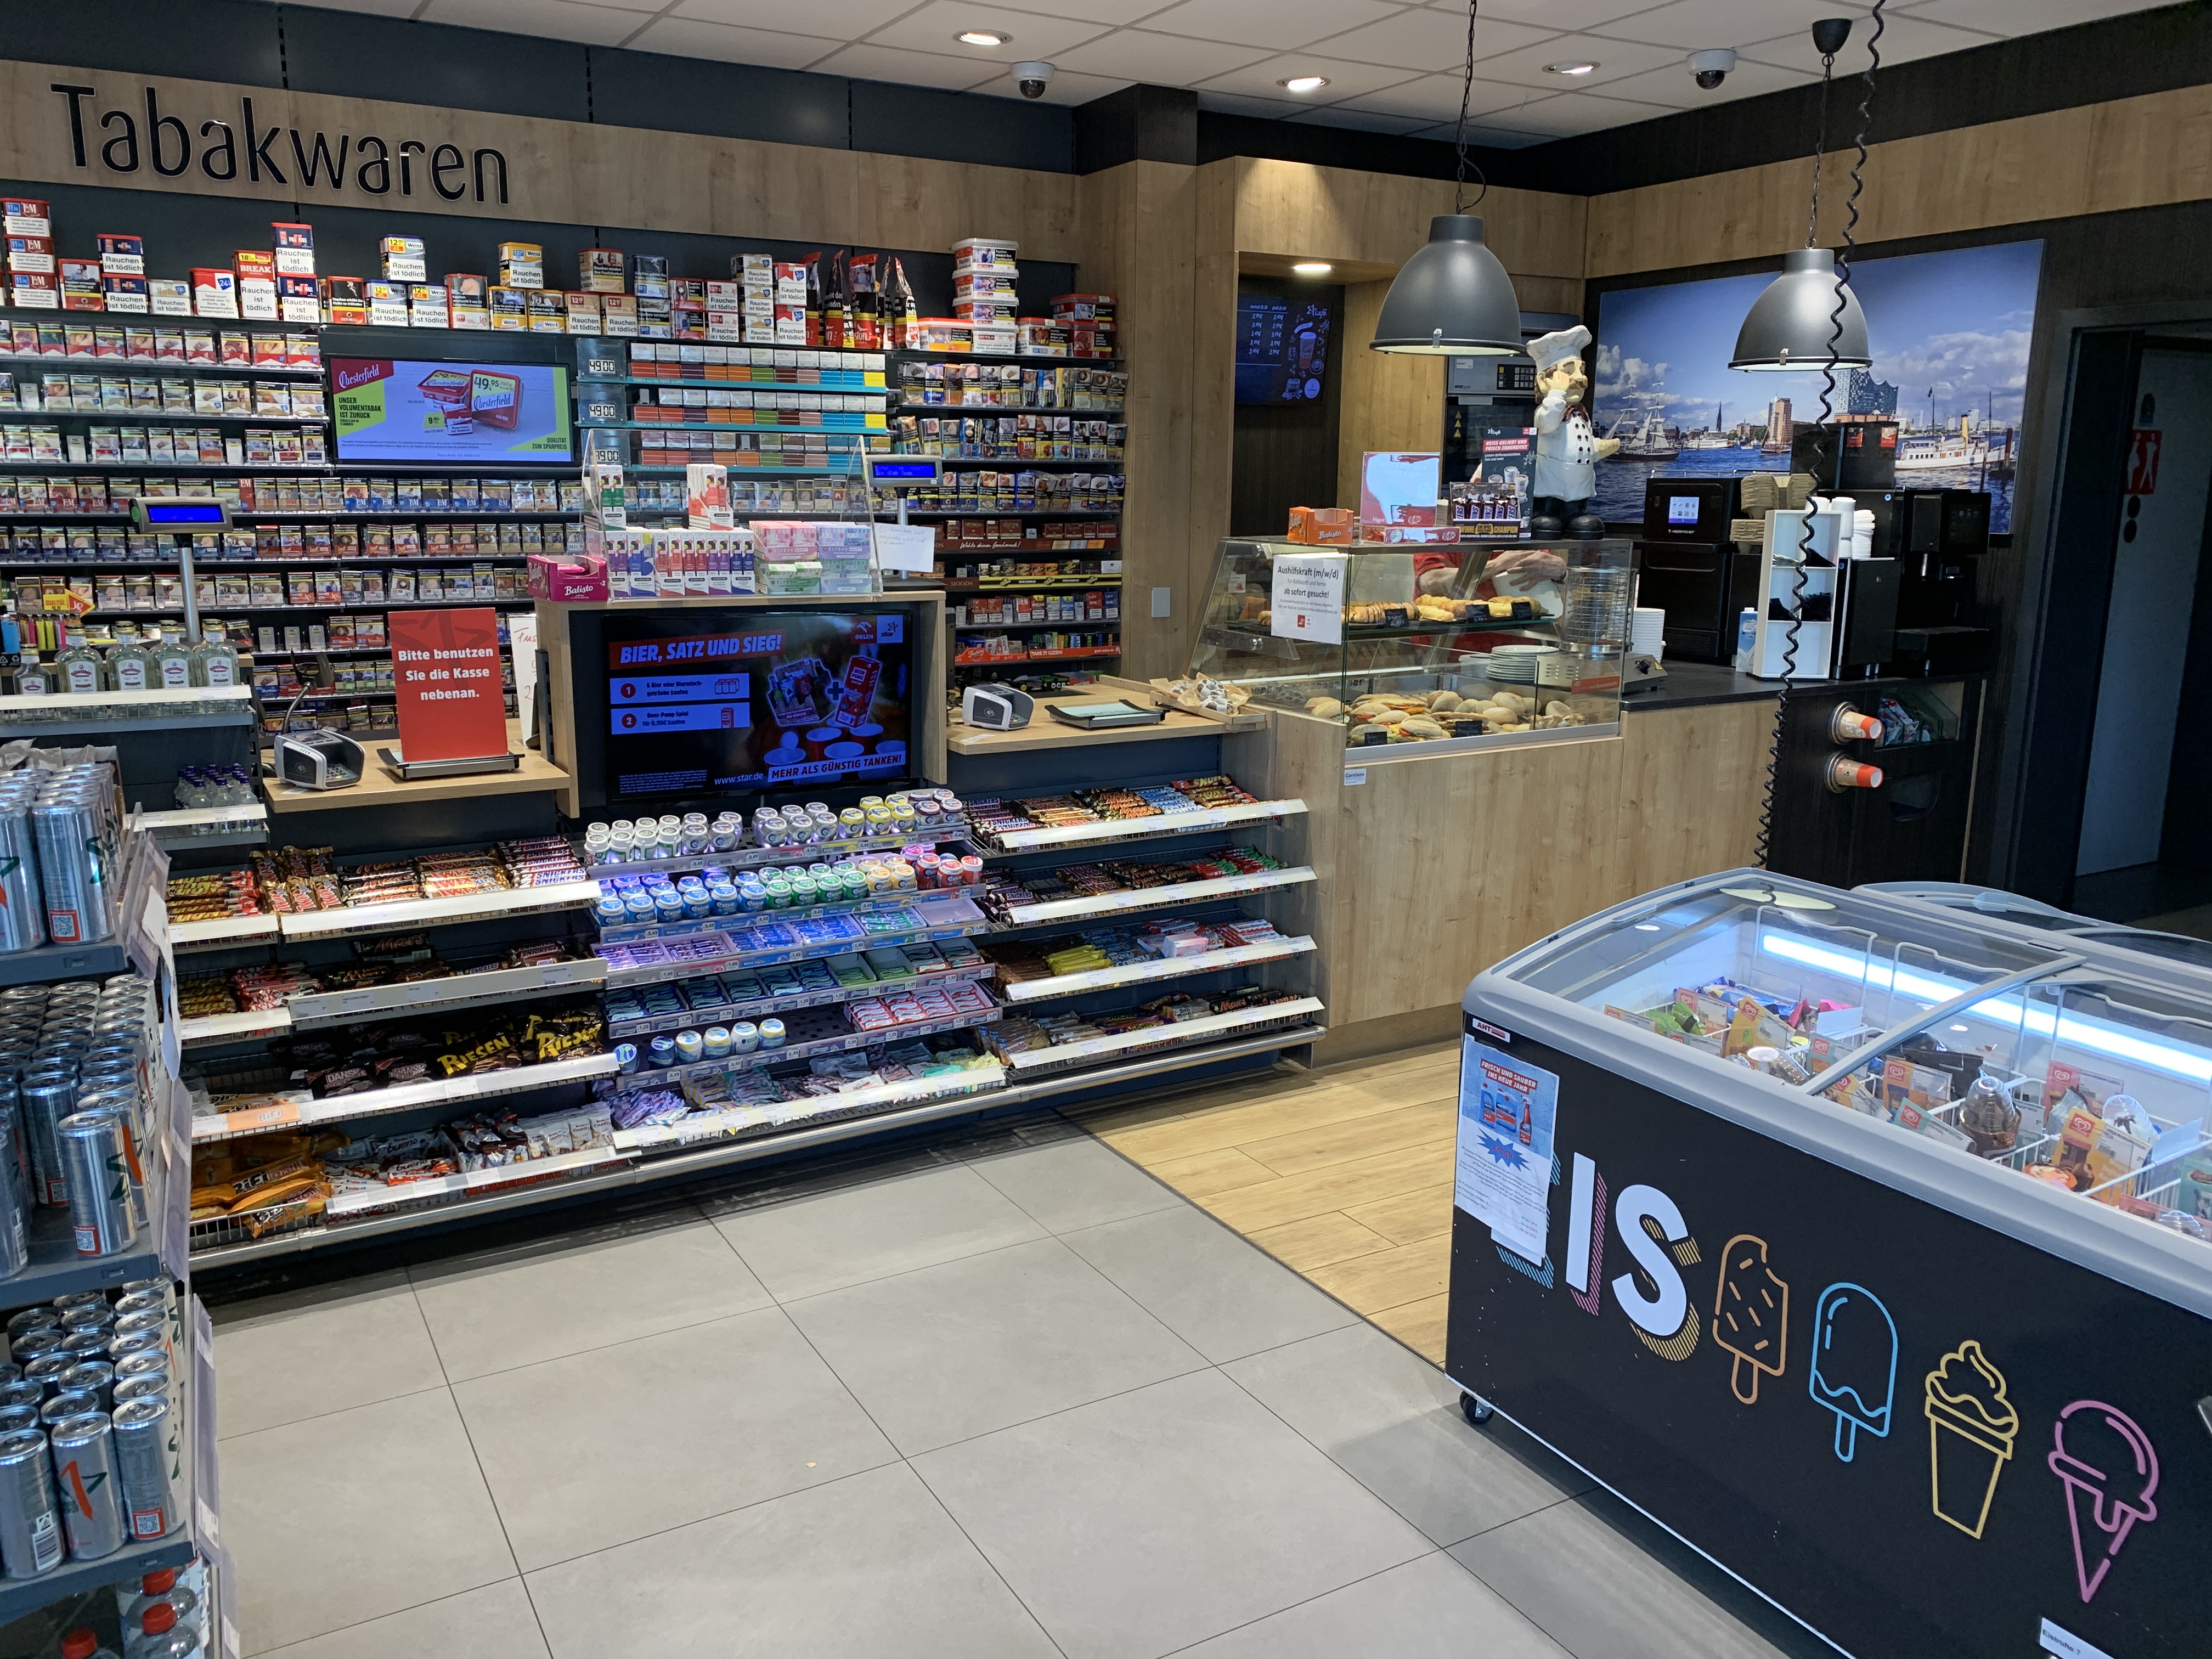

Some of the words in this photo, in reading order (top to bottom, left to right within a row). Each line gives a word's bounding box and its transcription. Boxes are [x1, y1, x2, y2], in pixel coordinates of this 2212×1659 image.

[50, 83, 510, 205] Tabakwaren
[105, 256, 139, 264] Rauchen
[113, 263, 142, 272] tödlich
[240, 265, 271, 273] BREAK
[110, 295, 143, 303] Rauchen
[1314, 308, 1328, 319] café
[338, 364, 380, 388] Chesterfield
[339, 404, 382, 413] VOLUMENTABAK
[474, 393, 511, 411] Chesterfield
[589, 405, 615, 416] 49.00
[1318, 530, 1341, 539] Balisto
[1278, 565, 1312, 576] Aushilfskraft
[1313, 567, 1339, 579] (m/w/d)
[565, 584, 594, 596] Balisto
[1291, 588, 1306, 597] sofort
[1307, 589, 1329, 599] gesucht!
[398, 649, 430, 662] Bitte
[433, 647, 494, 659] benutzen
[620, 645, 662, 664] BIER,
[667, 641, 704, 659] SATZ
[706, 638, 740, 656] UND
[742, 634, 782, 654] SIEG!
[405, 670, 426, 681] Sie
[429, 669, 449, 680] die
[453, 667, 490, 679] Kasse
[420, 688, 480, 701] nebenan.
[625, 686, 631, 695] 1
[626, 716, 633, 725] 2
[771, 767, 799, 780] MEHR
[800, 764, 819, 776] ALS
[821, 758, 862, 772] GÜNSTIG
[863, 754, 902, 769] TANKEN!
[714, 772, 764, 787] www.star.de
[969, 798, 1000, 807] SNICKERS
[991, 817, 1029, 826] SNICKERS
[536, 867, 585, 879] SNICKERS
[431, 878, 476, 889] TWIX
[474, 877, 495, 885] Xtra
[272, 893, 292, 912] TWIX
[294, 893, 317, 912] TWIX
[605, 916, 624, 924] extra
[636, 912, 654, 921] extra
[374, 933, 426, 953] Mars
[521, 945, 558, 957] SNICKERS
[1115, 953, 1150, 967] CORNY
[470, 962, 499, 974] SNICKERS
[1220, 997, 1246, 1012] Mars
[1477, 1022, 1492, 1033] AHT
[438, 1035, 511, 1075] RIESEN
[1006, 1042, 1028, 1055] hanuta
[1481, 1060, 1501, 1074] FRISCH
[1501, 1068, 1513, 1079] UND
[1514, 1074, 1537, 1088] SAUBER
[1487, 1071, 1498, 1080] INS
[1498, 1074, 1513, 1087] NEUE
[1513, 1082, 1528, 1093] JAHR
[258, 1109, 281, 1122] BiFi
[387, 1138, 418, 1153] bueno
[396, 1159, 428, 1171] bueno
[233, 1171, 269, 1194] BiFi
[269, 1160, 302, 1179] Roll
[2042, 1628, 2074, 1653] Eistruhe
